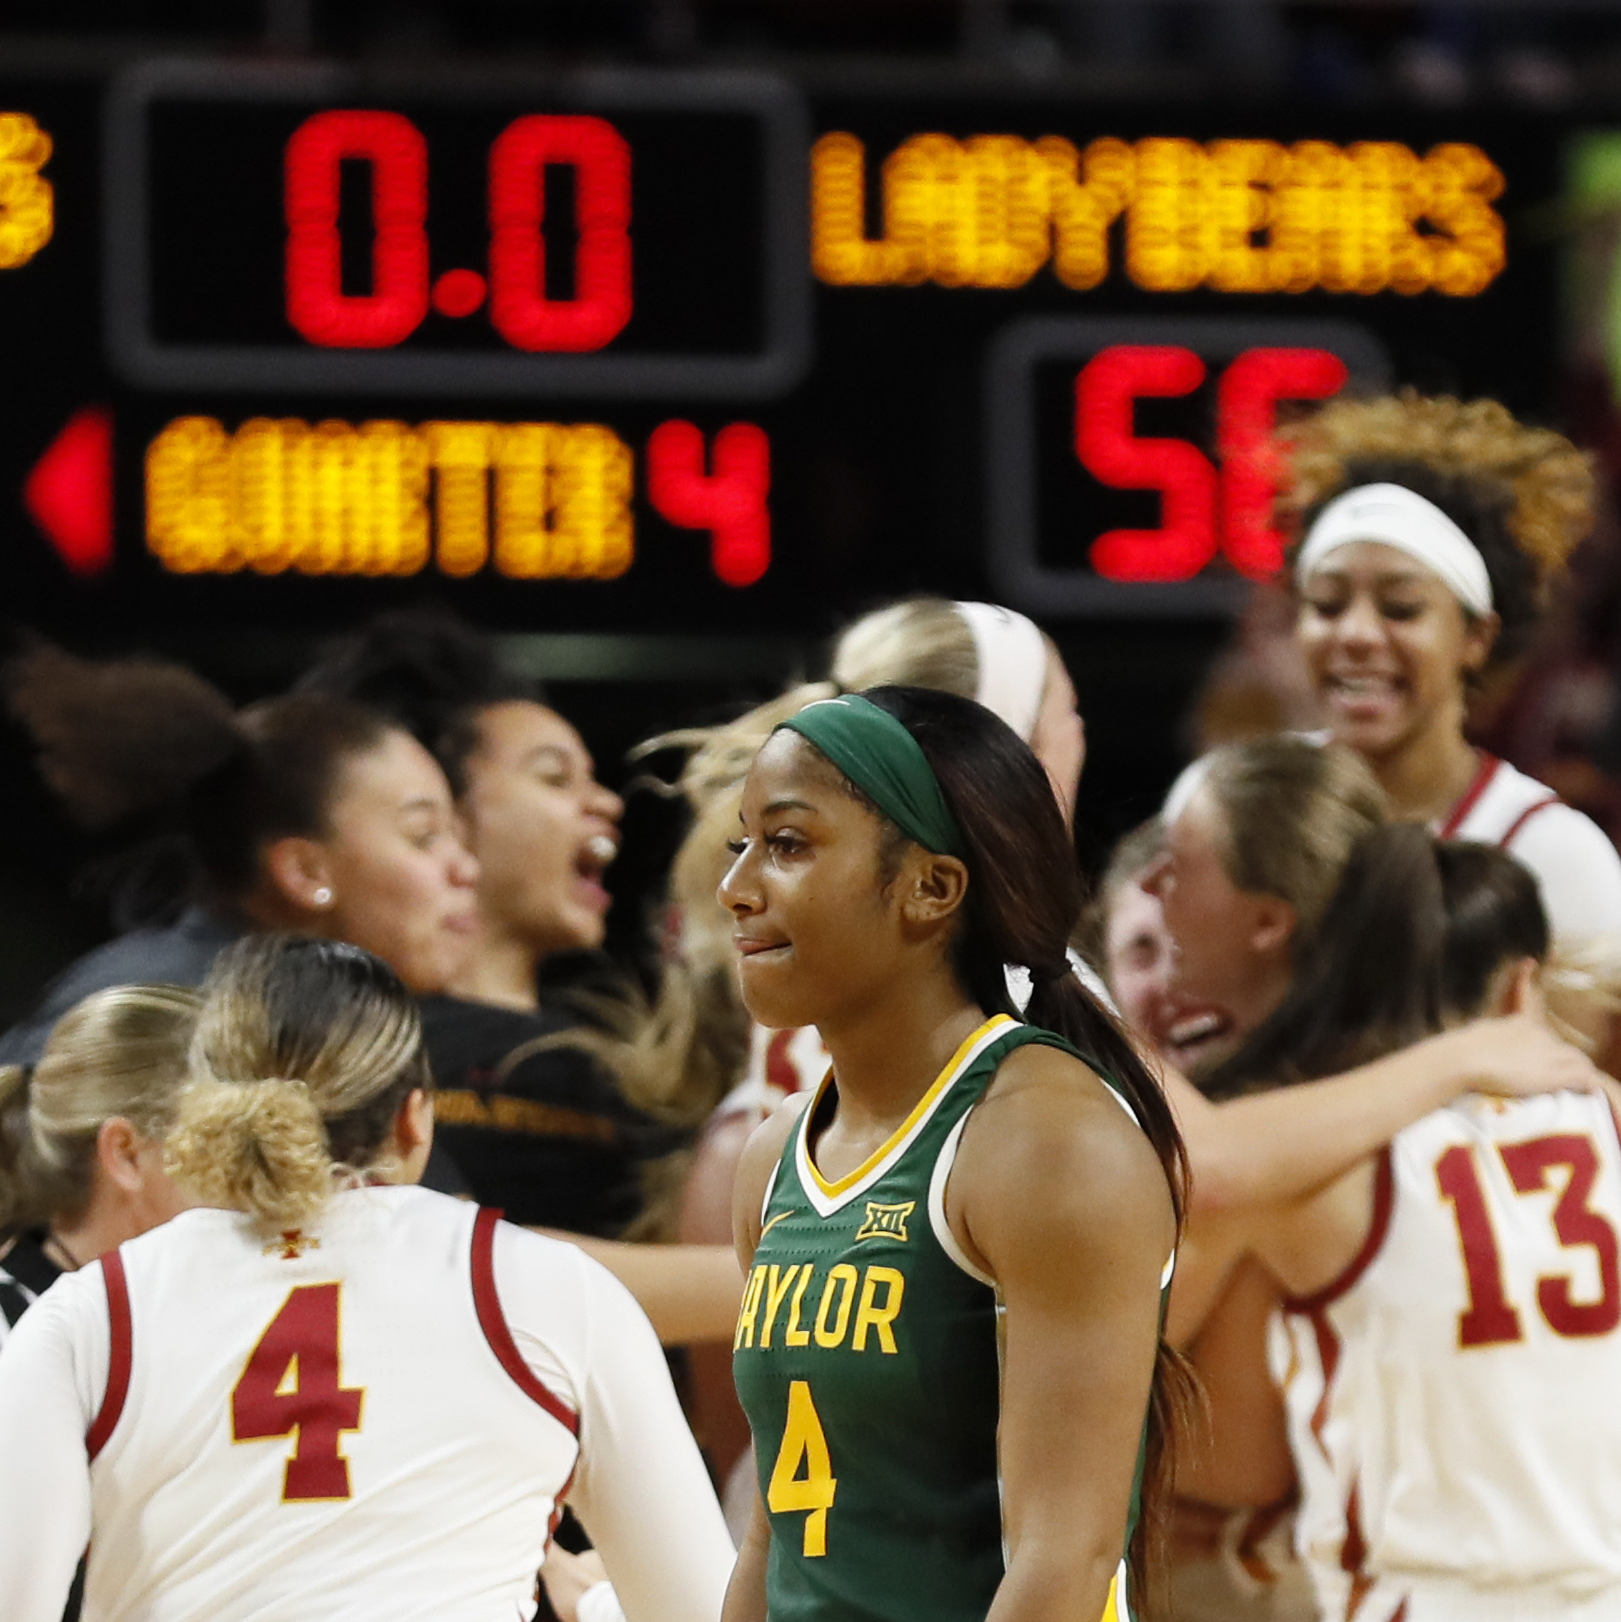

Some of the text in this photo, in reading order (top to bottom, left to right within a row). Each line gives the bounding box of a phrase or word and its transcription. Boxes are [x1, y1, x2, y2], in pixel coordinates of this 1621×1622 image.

[285, 109, 633, 352] 0.0
[646, 419, 771, 587] 4
[229, 1279, 366, 1503] 4
[734, 1263, 906, 1354] AYLOR
[767, 1380, 837, 1558] 4
